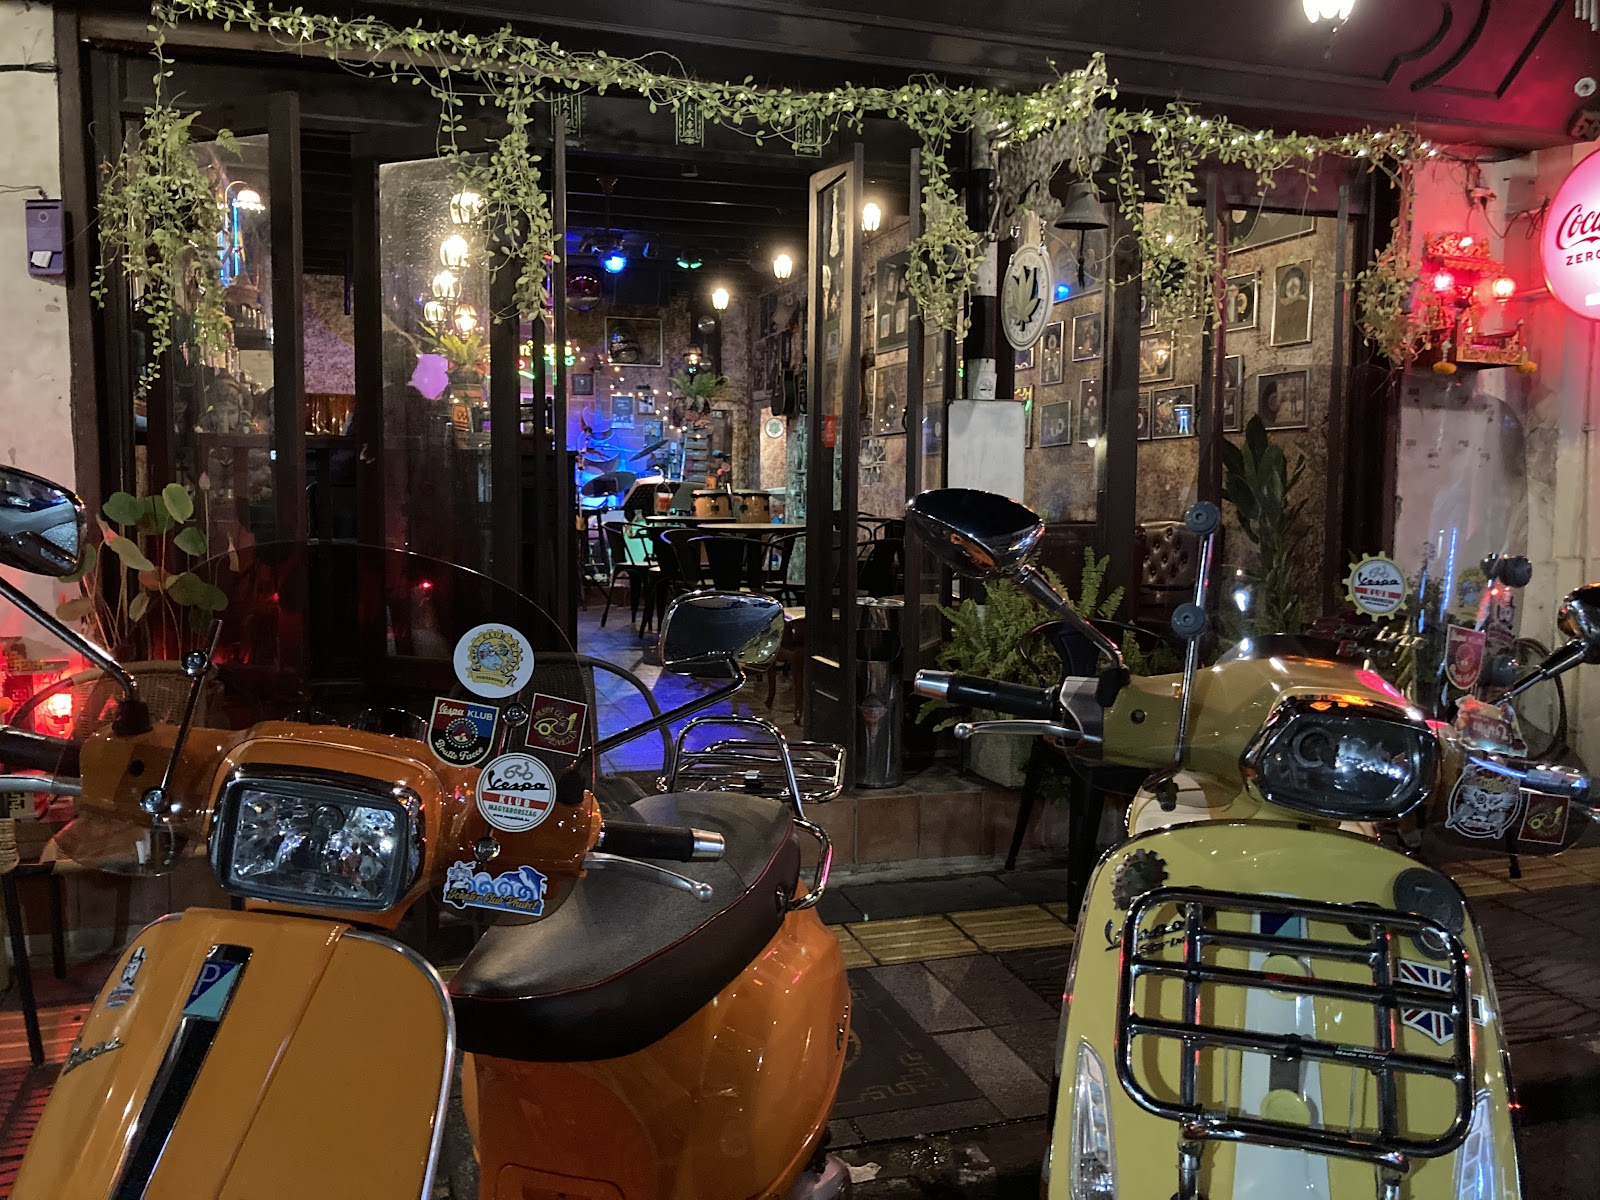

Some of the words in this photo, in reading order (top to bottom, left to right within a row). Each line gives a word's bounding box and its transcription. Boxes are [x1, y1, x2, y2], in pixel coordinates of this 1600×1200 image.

[1358, 572, 1400, 586] Vespa
[483, 631, 506, 641] CLUB
[437, 702, 465, 717] Vespa
[467, 709, 493, 721] KLUB
[486, 769, 550, 792] Vespa
[499, 794, 531, 808] KLUB
[488, 804, 537, 818] MAGYARORSZÁG
[447, 887, 480, 902] Scooter
[482, 892, 506, 906] Club
[505, 895, 540, 910] Phuket
[193, 963, 221, 996] P
[1334, 1050, 1357, 1058] Made
